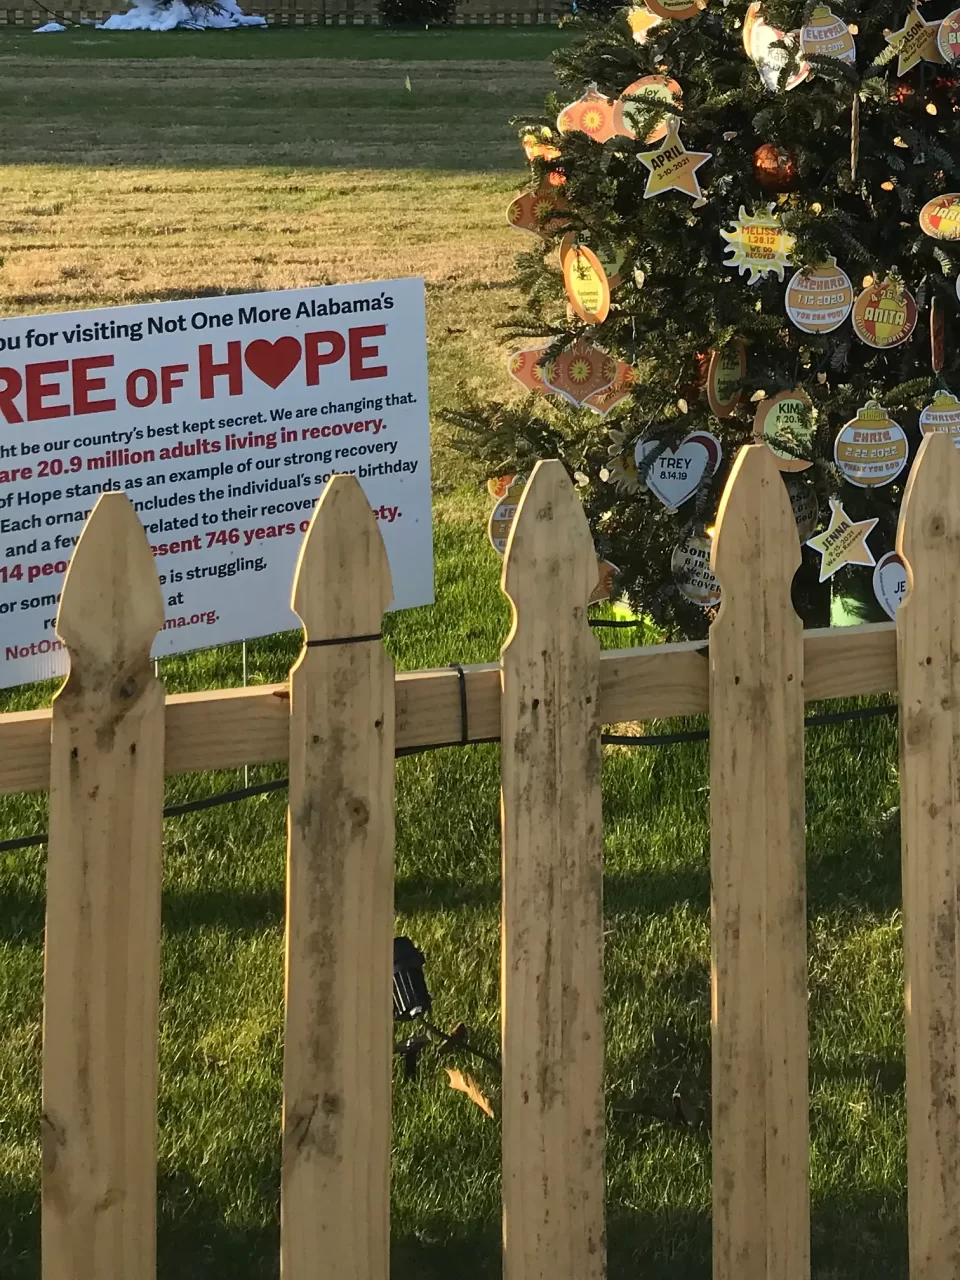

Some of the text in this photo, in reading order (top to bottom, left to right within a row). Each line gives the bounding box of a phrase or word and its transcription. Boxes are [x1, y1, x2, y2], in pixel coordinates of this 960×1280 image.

[650, 144, 684, 171] APRIL
[657, 157, 690, 181] 3-10-2021
[741, 226, 782, 236] MELISSA
[748, 236, 775, 244] 1.28.12
[797, 278, 844, 291] RICHARD
[0, 292, 394, 351] ou for visiting Not One More Alabama's
[864, 307, 905, 325] ANITA
[0, 354, 116, 424] REE
[126, 363, 189, 408] OF
[778, 403, 799, 414] KIM
[0, 392, 417, 459] ht be our country's best kept secret. We are changing that.
[0, 419, 387, 483] are 20.9 million adults living in recovery.
[659, 458, 692, 469] TREY
[0, 440, 398, 509] of Hope stands as an example of our strong recovery
[660, 472, 688, 481] 8.14.19
[844, 462, 899, 472] THANK YOU GOD
[1, 515, 42, 533] Each
[45, 509, 92, 526] orna
[198, 486, 224, 502] the
[228, 474, 311, 497] individual's
[358, 459, 418, 478] birthday
[5, 496, 318, 558] and a related to their recover
[821, 520, 851, 551] JENNA
[28, 561, 71, 583] peo
[151, 535, 202, 557] esent
[204, 528, 240, 549] 746
[244, 520, 295, 546] years
[170, 571, 183, 583] is
[186, 557, 267, 581] struggling,
[703, 571, 715, 581] Do
[167, 591, 184, 606] at
